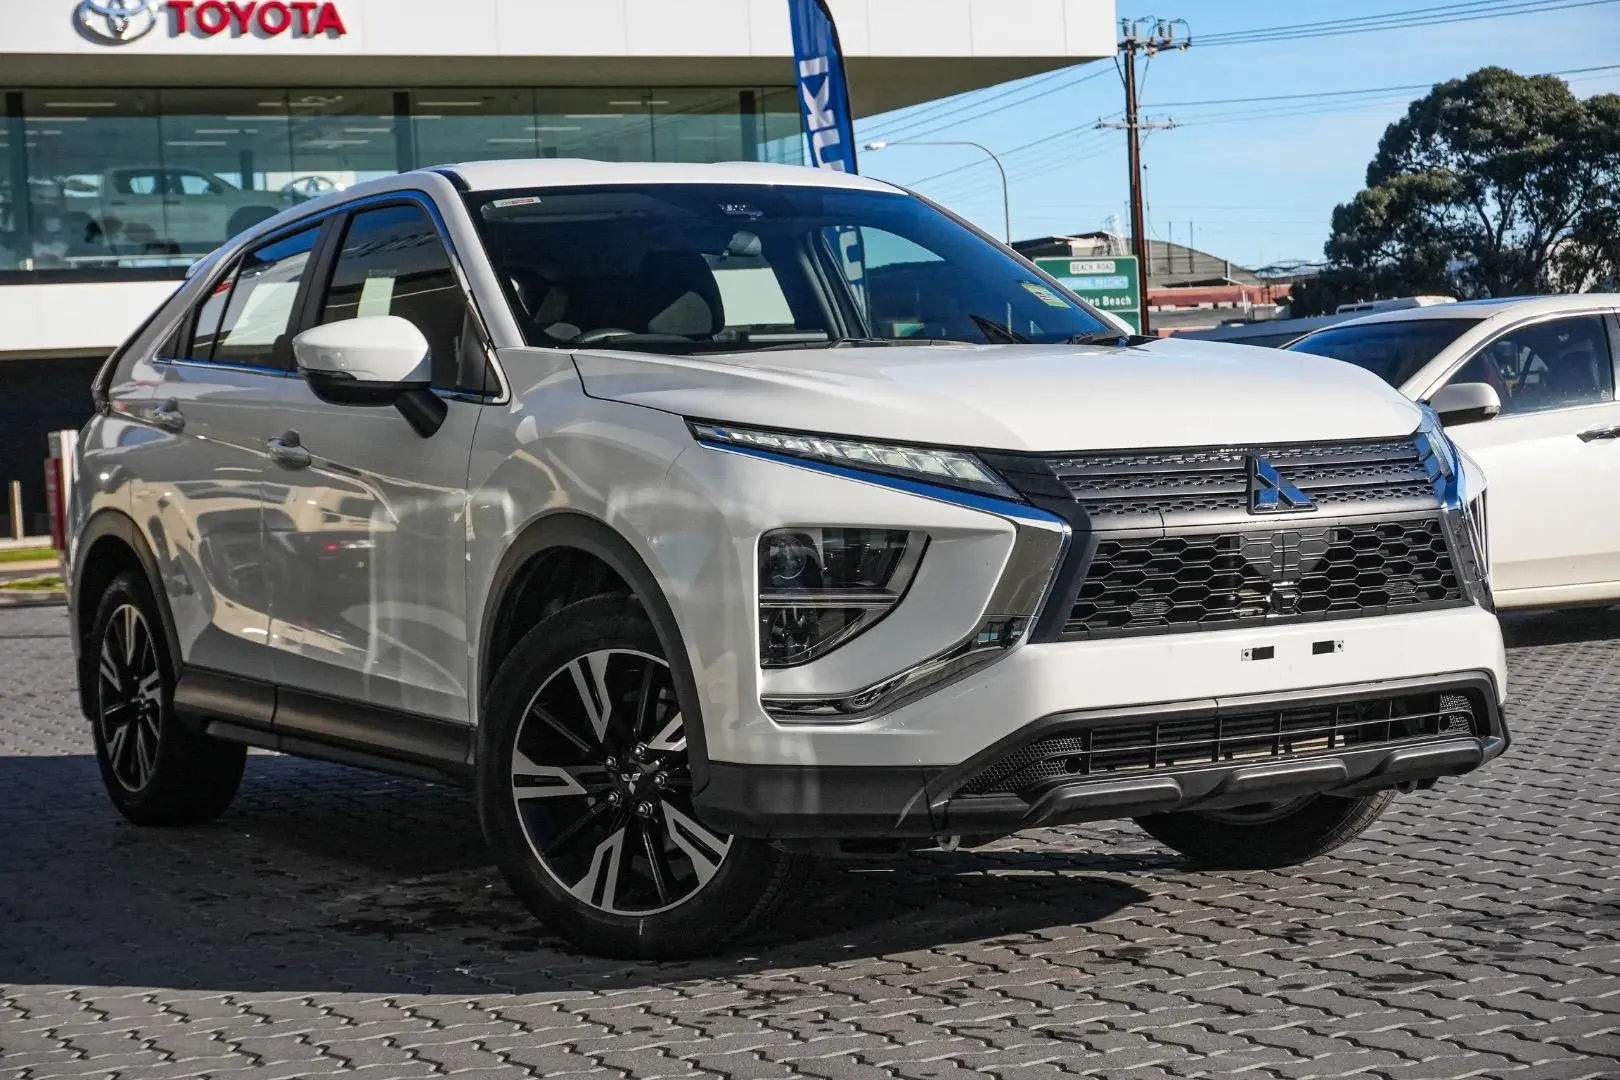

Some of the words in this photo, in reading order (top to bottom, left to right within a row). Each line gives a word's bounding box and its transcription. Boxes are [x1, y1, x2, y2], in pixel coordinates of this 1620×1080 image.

[167, 1, 347, 35] TOYOTA
[1071, 263, 1093, 272] BEACH
[1096, 262, 1113, 271] ROAD
[1102, 295, 1132, 306] Beach
